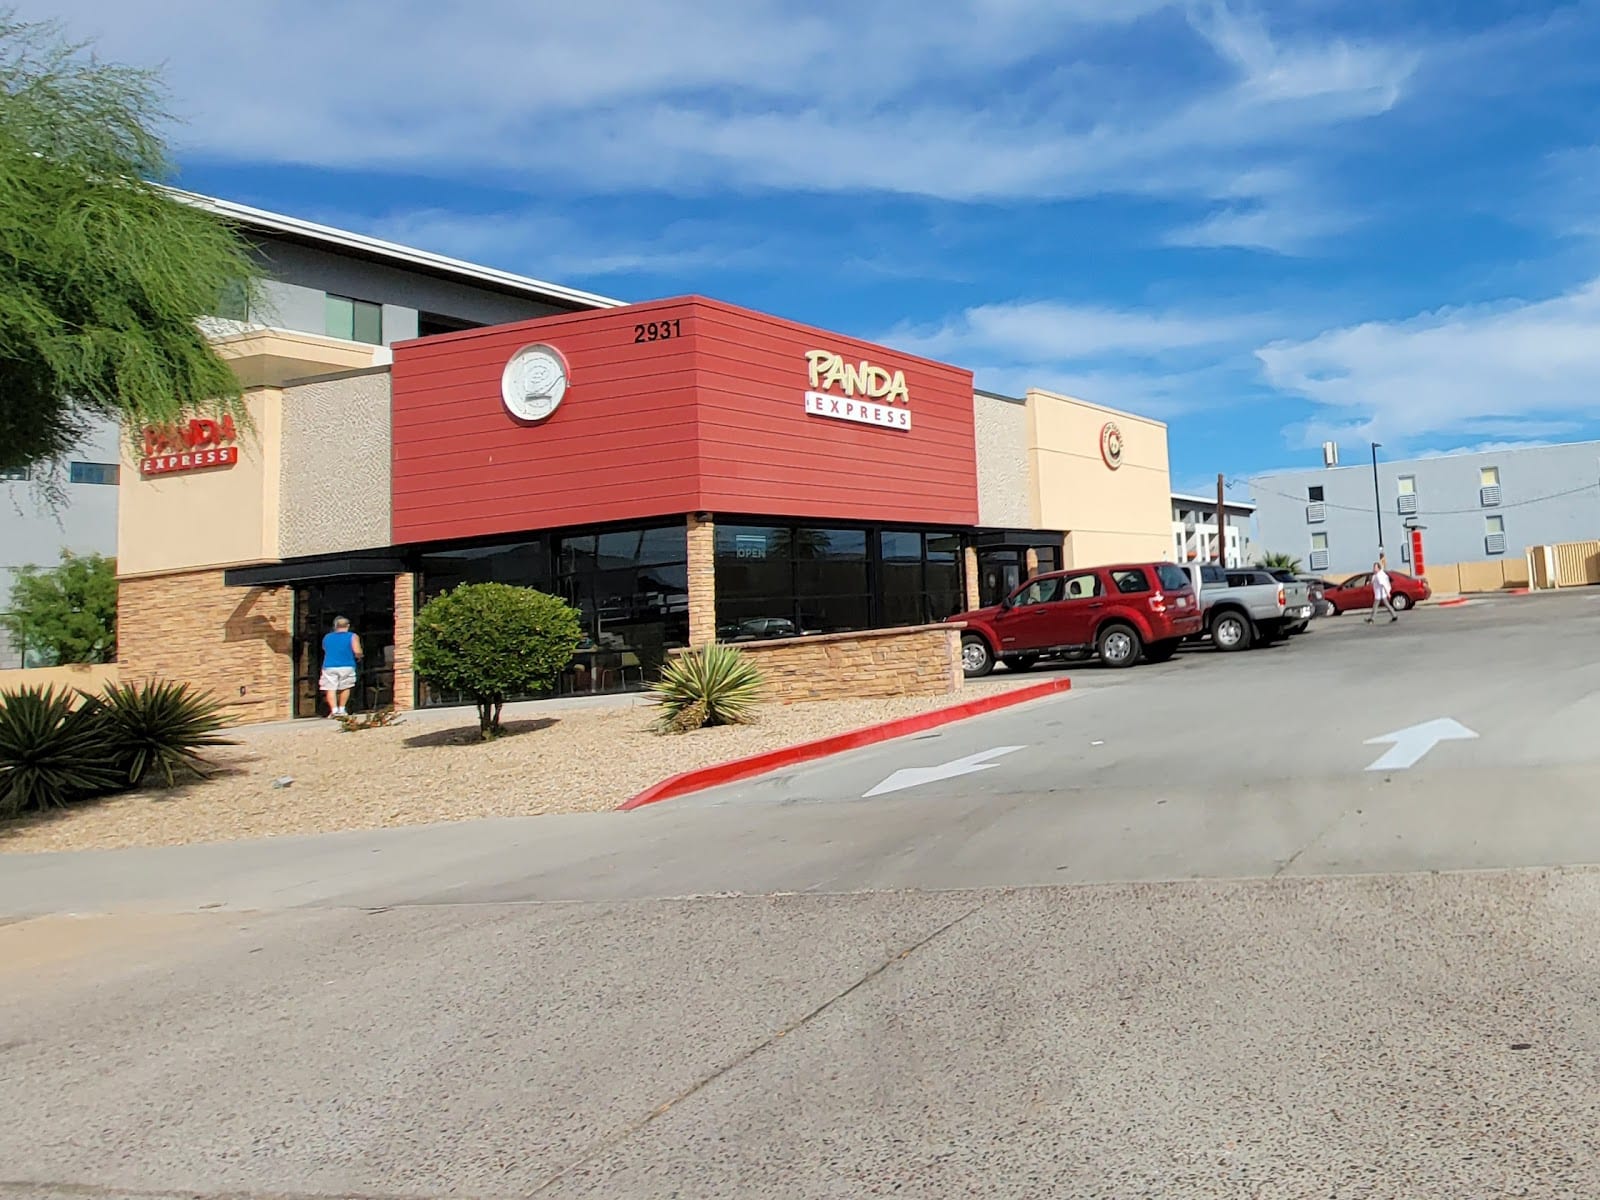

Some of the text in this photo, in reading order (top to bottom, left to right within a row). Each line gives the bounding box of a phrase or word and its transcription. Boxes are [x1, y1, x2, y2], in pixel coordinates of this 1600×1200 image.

[634, 319, 682, 343] 2931
[805, 349, 909, 403] PANDA
[815, 397, 907, 425] EXPRESS
[143, 450, 229, 471] EXPRESS
[737, 547, 767, 559] OPEN
